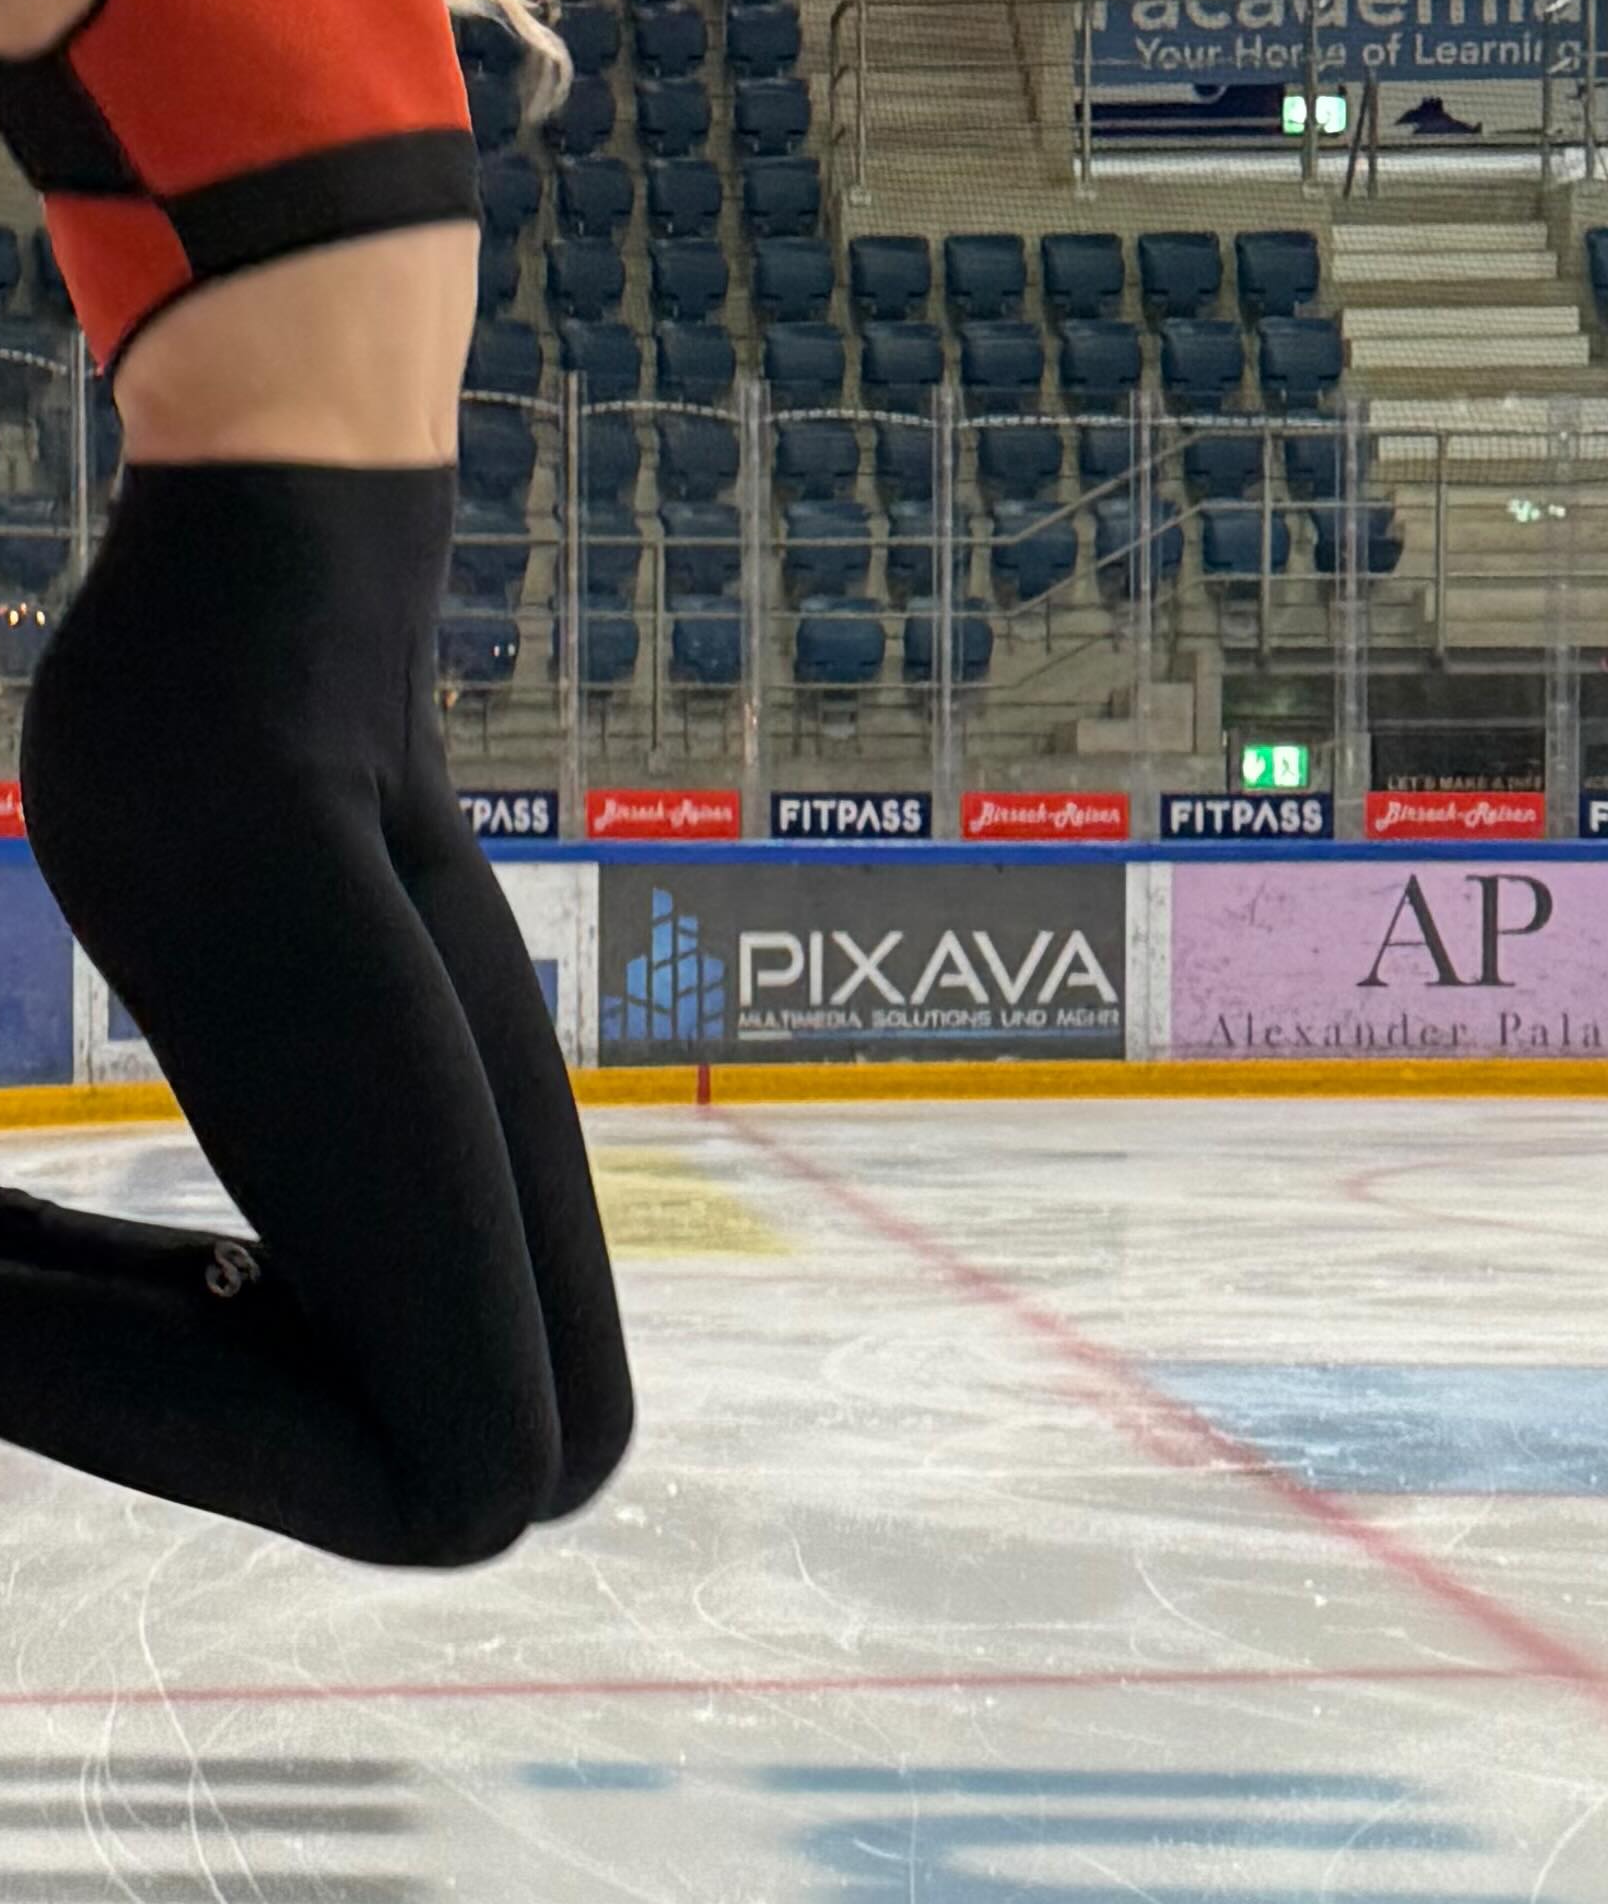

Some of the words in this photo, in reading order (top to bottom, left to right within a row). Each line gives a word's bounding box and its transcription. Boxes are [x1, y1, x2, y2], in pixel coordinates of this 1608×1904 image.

[1135, 35, 1221, 70] Your
[1362, 32, 1403, 67] of
[458, 797, 550, 833] PASS
[779, 798, 922, 833] FITPASS
[1170, 800, 1323, 833] FITPASS
[1356, 873, 1554, 987] AP
[738, 929, 1119, 1006] PIXAVA
[737, 1009, 862, 1029] MULTIMEDIA
[871, 1008, 992, 1029] SOLUTIONS
[1001, 1007, 1048, 1028] UND
[1205, 1010, 1475, 1048] Alexander
